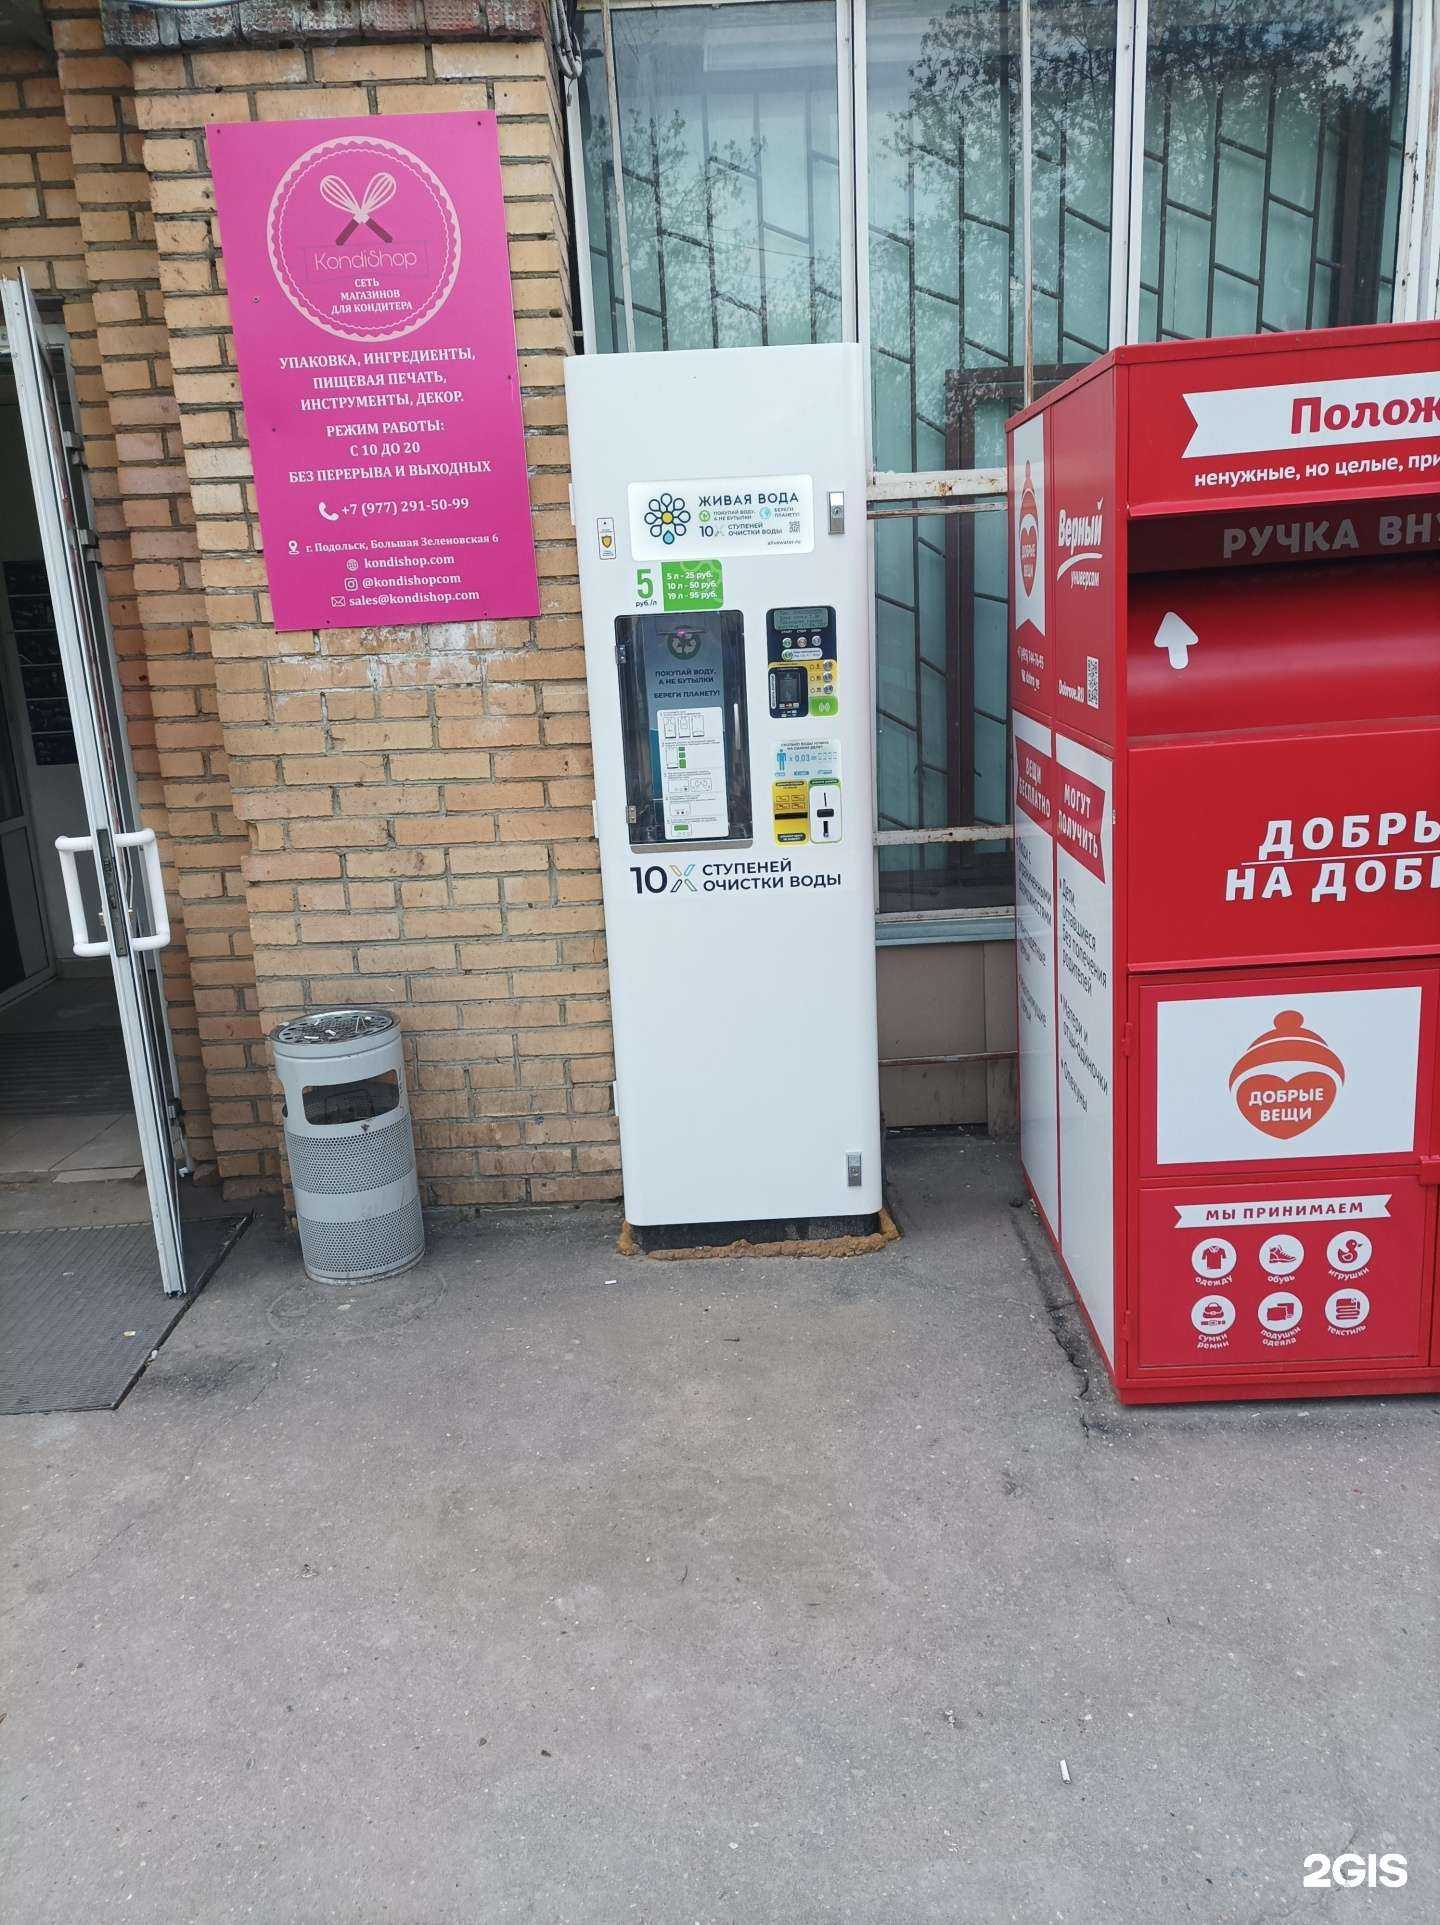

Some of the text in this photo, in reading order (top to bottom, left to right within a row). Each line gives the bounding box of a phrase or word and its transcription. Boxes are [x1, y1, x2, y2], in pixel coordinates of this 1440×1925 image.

[315, 249, 417, 271] KondiShop
[354, 278, 380, 288] СЕТЬ
[340, 289, 400, 301] МАГАЗИНОВ
[331, 300, 413, 316] ДЛЯ КОНДИТЕРА
[279, 348, 476, 370] УПАКОВКА, ИНГРЕДИЕНТЫ,
[313, 370, 447, 390] ПИЩЕВАЯ ПЕЧАТЬ,
[300, 390, 464, 411] ИНСТРУМЕНТЫ, ДЕКОР.
[326, 419, 445, 438] РЕЖИМ РАБОТЫ:
[350, 441, 421, 457] С 10 ДО 20
[289, 460, 492, 484] БЕЗ ПЕРЕРЫВА И ВЫХОДНЫХ
[1194, 464, 1300, 488] ненужные,
[1305, 462, 1330, 478] но
[1335, 456, 1404, 476] целые,
[341, 498, 470, 517] +7 (977) 291-50-99
[698, 492, 799, 507] ЖИВАЯ ВОДА
[728, 522, 763, 530] СТУПЕНЕЙ
[1057, 497, 1104, 555] Верный
[305, 532, 499, 554] г. Подольск, Большая Зеленовская 6
[1222, 518, 1360, 559] РУЧКА
[364, 554, 455, 570] kondishop.com
[362, 574, 461, 590] @kondishopcom
[636, 568, 654, 599] 5
[666, 572, 672, 580] 5
[696, 571, 714, 580] руб.
[1070, 570, 1100, 591] универсам
[667, 582, 676, 590] 10
[690, 581, 699, 589] 50
[701, 580, 718, 591] руб.
[348, 590, 480, 608] sales@kondishop.com
[635, 600, 658, 608] руб./л
[668, 592, 677, 600] 19
[690, 591, 700, 599] 95
[701, 590, 718, 600] руб.
[655, 668, 716, 677] ПОКУПАЙ ВОДУ,
[679, 676, 714, 684] БУТЫЛКИ
[654, 690, 720, 699] БЕРЕГИ ПЛАНЕТУ!
[1026, 758, 1041, 785] ВЕЩИ
[1018, 776, 1051, 819] БЕСПЛАТНО
[1064, 783, 1091, 819] МОГУТ
[1058, 809, 1098, 859] ПОЛУЧИТЬ
[702, 858, 792, 876] СТУПЕНЕЙ
[703, 874, 842, 892] ОЧИСТКИ ВОДЫ
[1225, 866, 1293, 902] НА
[1062, 878, 1075, 911] Дети,
[1062, 905, 1096, 953] оставшиеся
[1072, 937, 1108, 990] попечения
[1062, 949, 1092, 997] родителей
[1248, 1088, 1324, 1107] ДОБРЫЕ
[1260, 1107, 1312, 1124] ВЕЩИ
[1206, 1202, 1364, 1221] МЫ ПРИНИМАЕМ
[1195, 1276, 1234, 1287] одежду
[1267, 1274, 1296, 1286] обувь
[1328, 1267, 1370, 1281] игрушки
[1198, 1333, 1228, 1344] сумки
[1260, 1326, 1302, 1342] подушки
[1327, 1324, 1368, 1337] текстиль
[1196, 1340, 1230, 1351] ремни
[1262, 1336, 1297, 1348] одеяла
